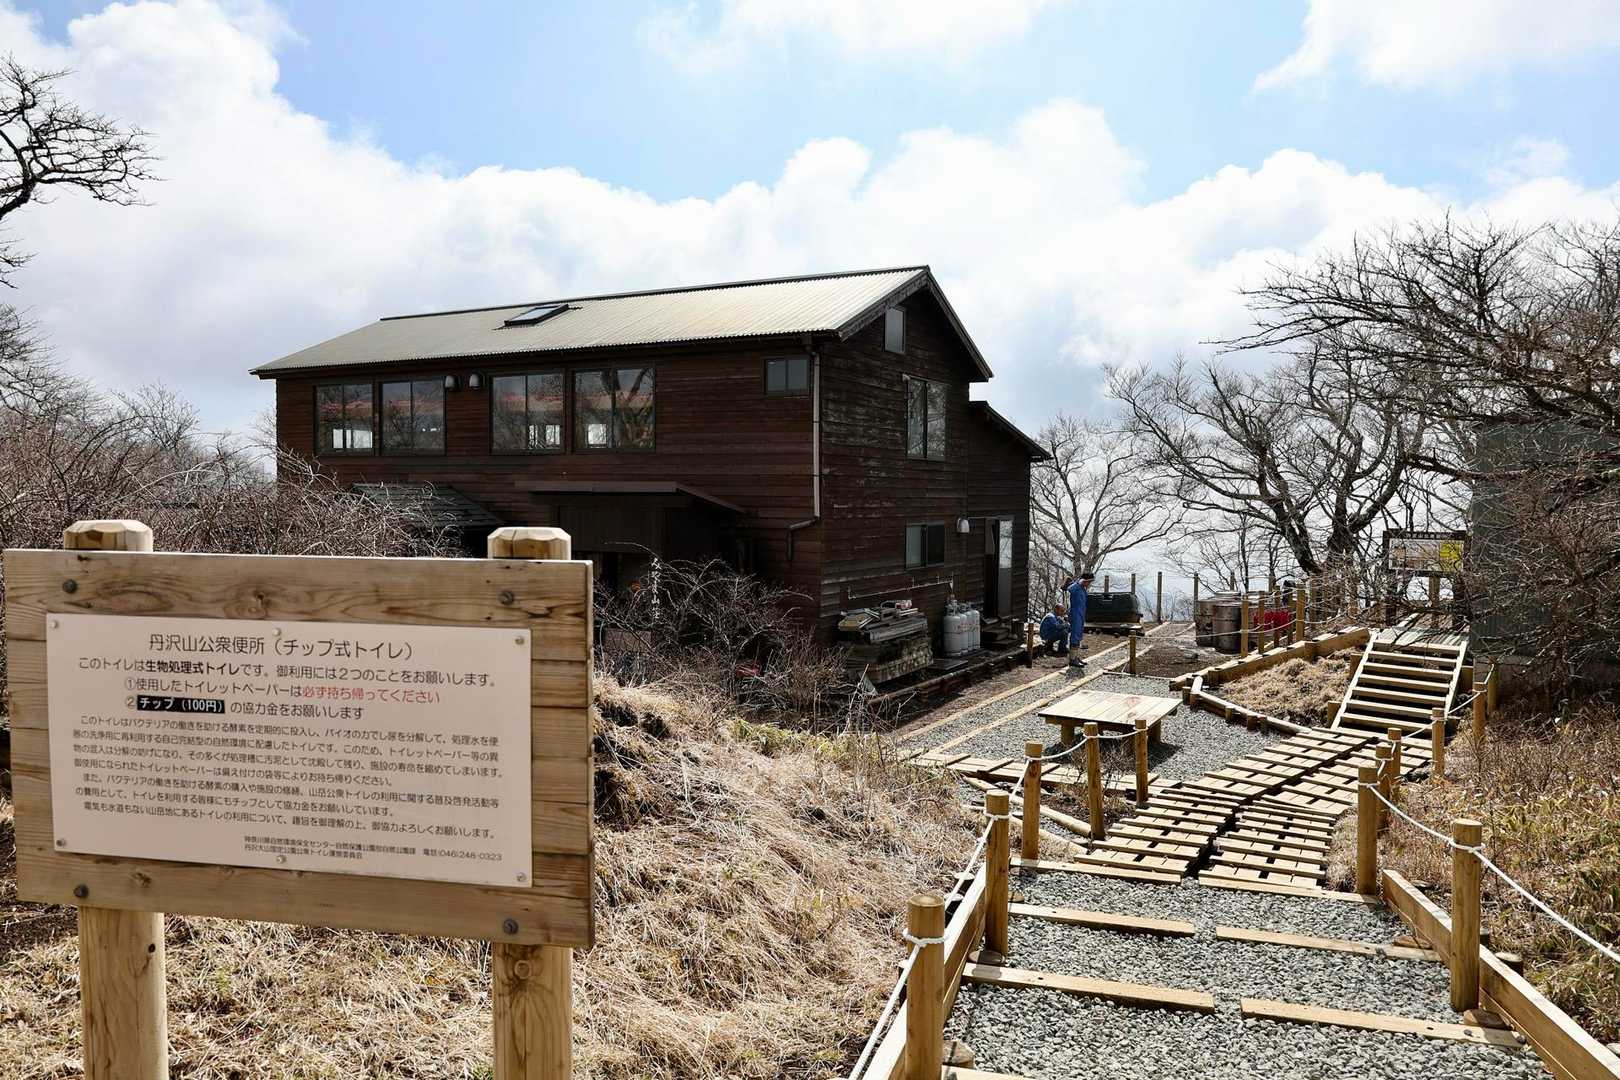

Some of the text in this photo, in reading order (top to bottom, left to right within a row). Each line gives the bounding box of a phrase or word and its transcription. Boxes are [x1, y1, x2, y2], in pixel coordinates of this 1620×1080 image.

[148, 633, 412, 661] 丹沢山公衆便所（チップ式トイレ）
[79, 656, 495, 686] このトイレは生物処理式トイレです。御利用には2つのことをお願いします。
[125, 677, 439, 704] ①使用したトイレットペーパーは必ず持ち帰ってください
